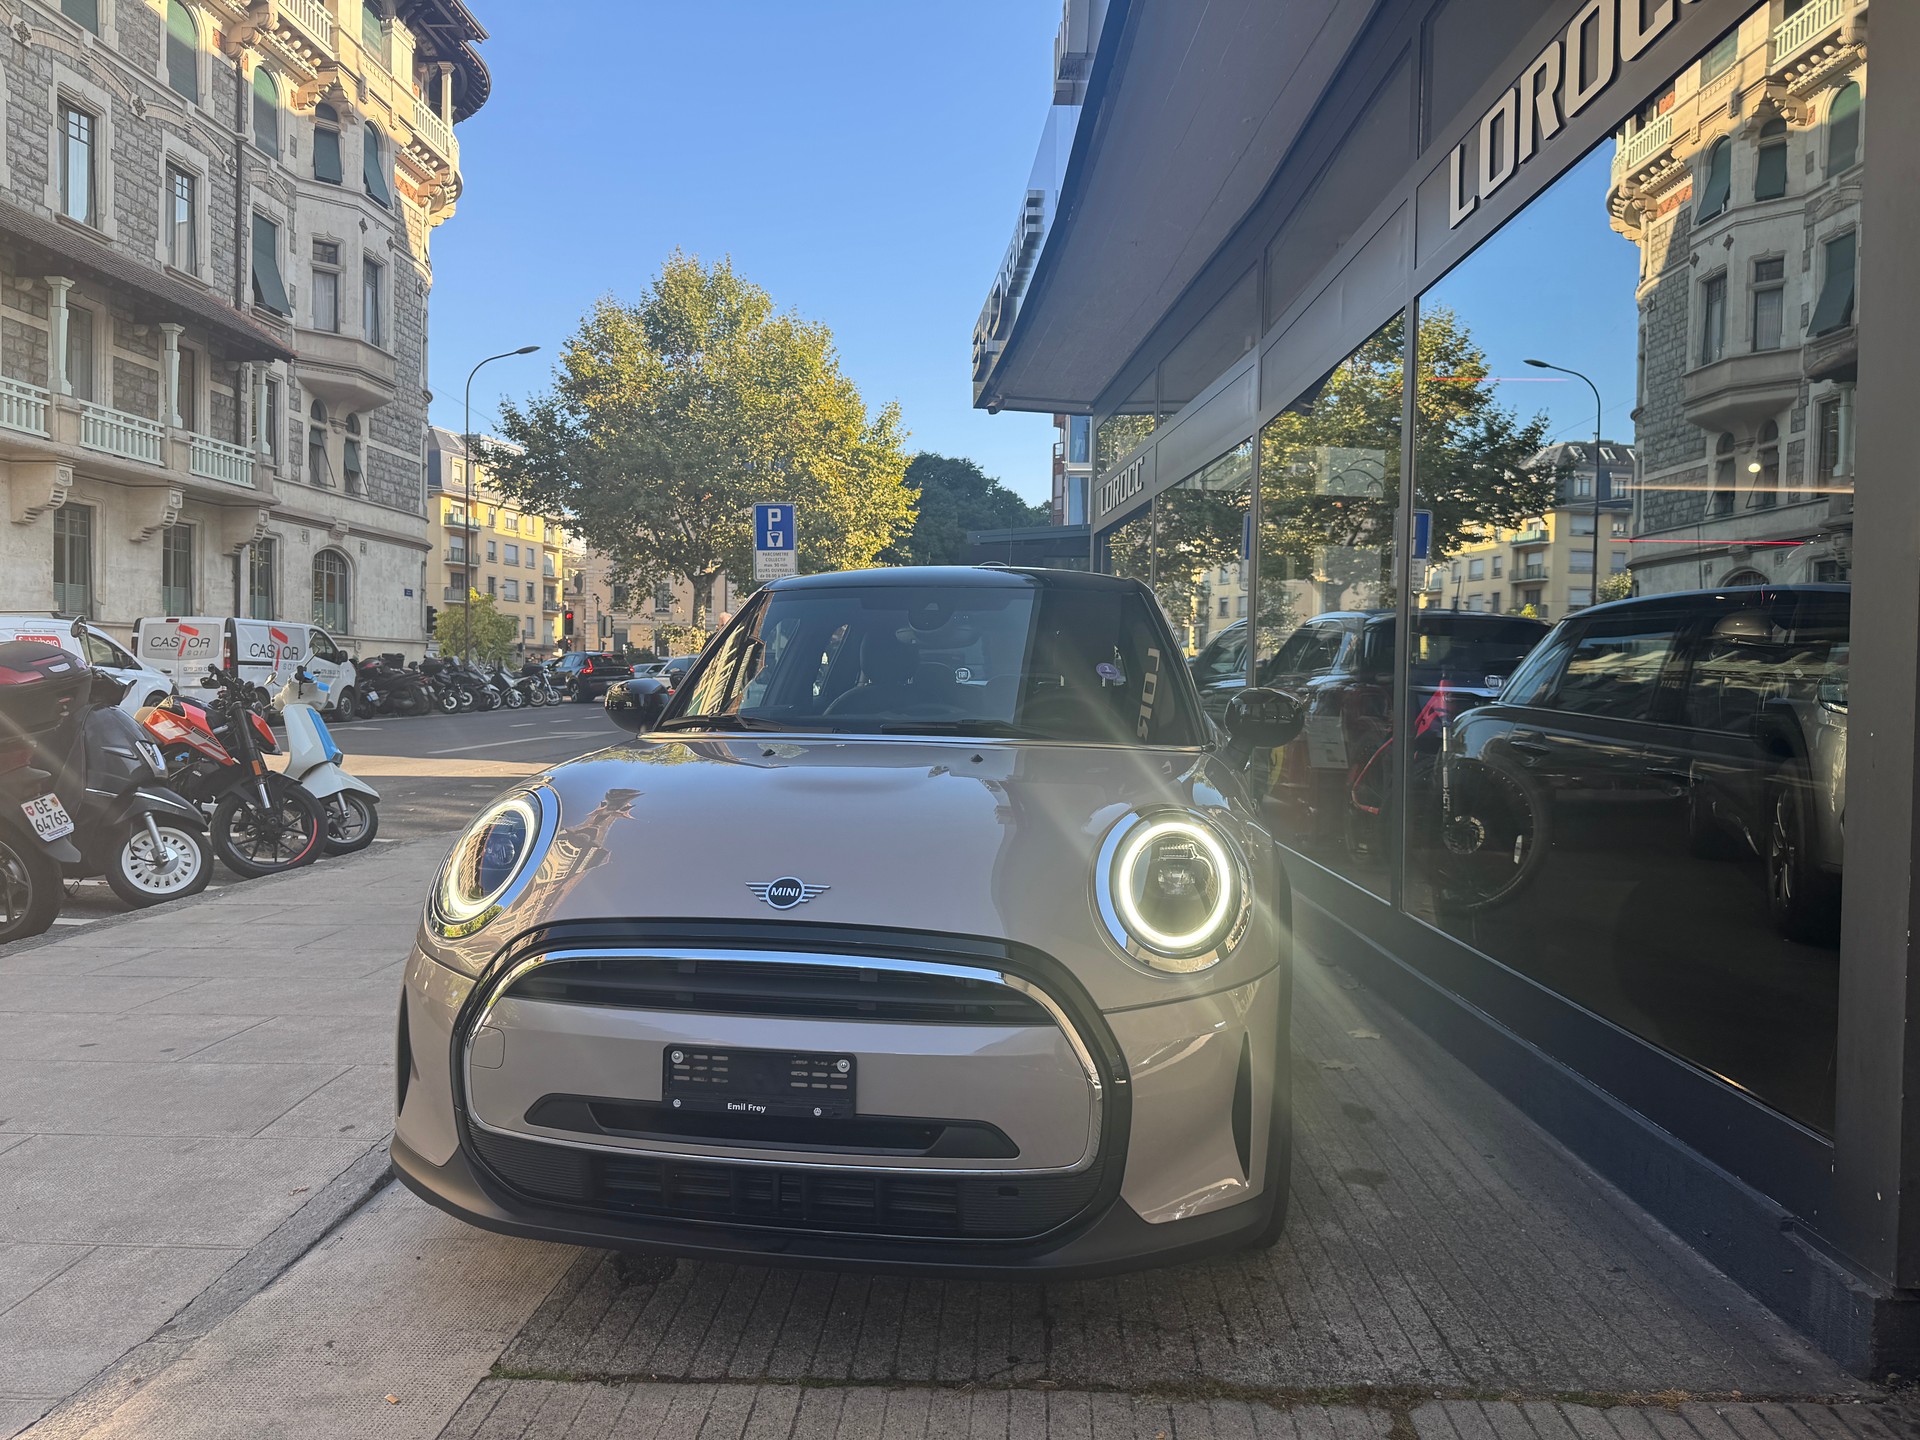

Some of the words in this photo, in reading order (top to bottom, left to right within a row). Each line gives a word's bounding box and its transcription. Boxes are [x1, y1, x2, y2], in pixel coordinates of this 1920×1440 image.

[1449, 0, 1693, 229] LOROC
[767, 508, 782, 530] P
[34, 798, 52, 814] GE
[35, 810, 69, 833] 64765
[770, 887, 800, 897] MINI
[727, 1103, 746, 1111] Emil
[748, 1104, 767, 1113] Frey
